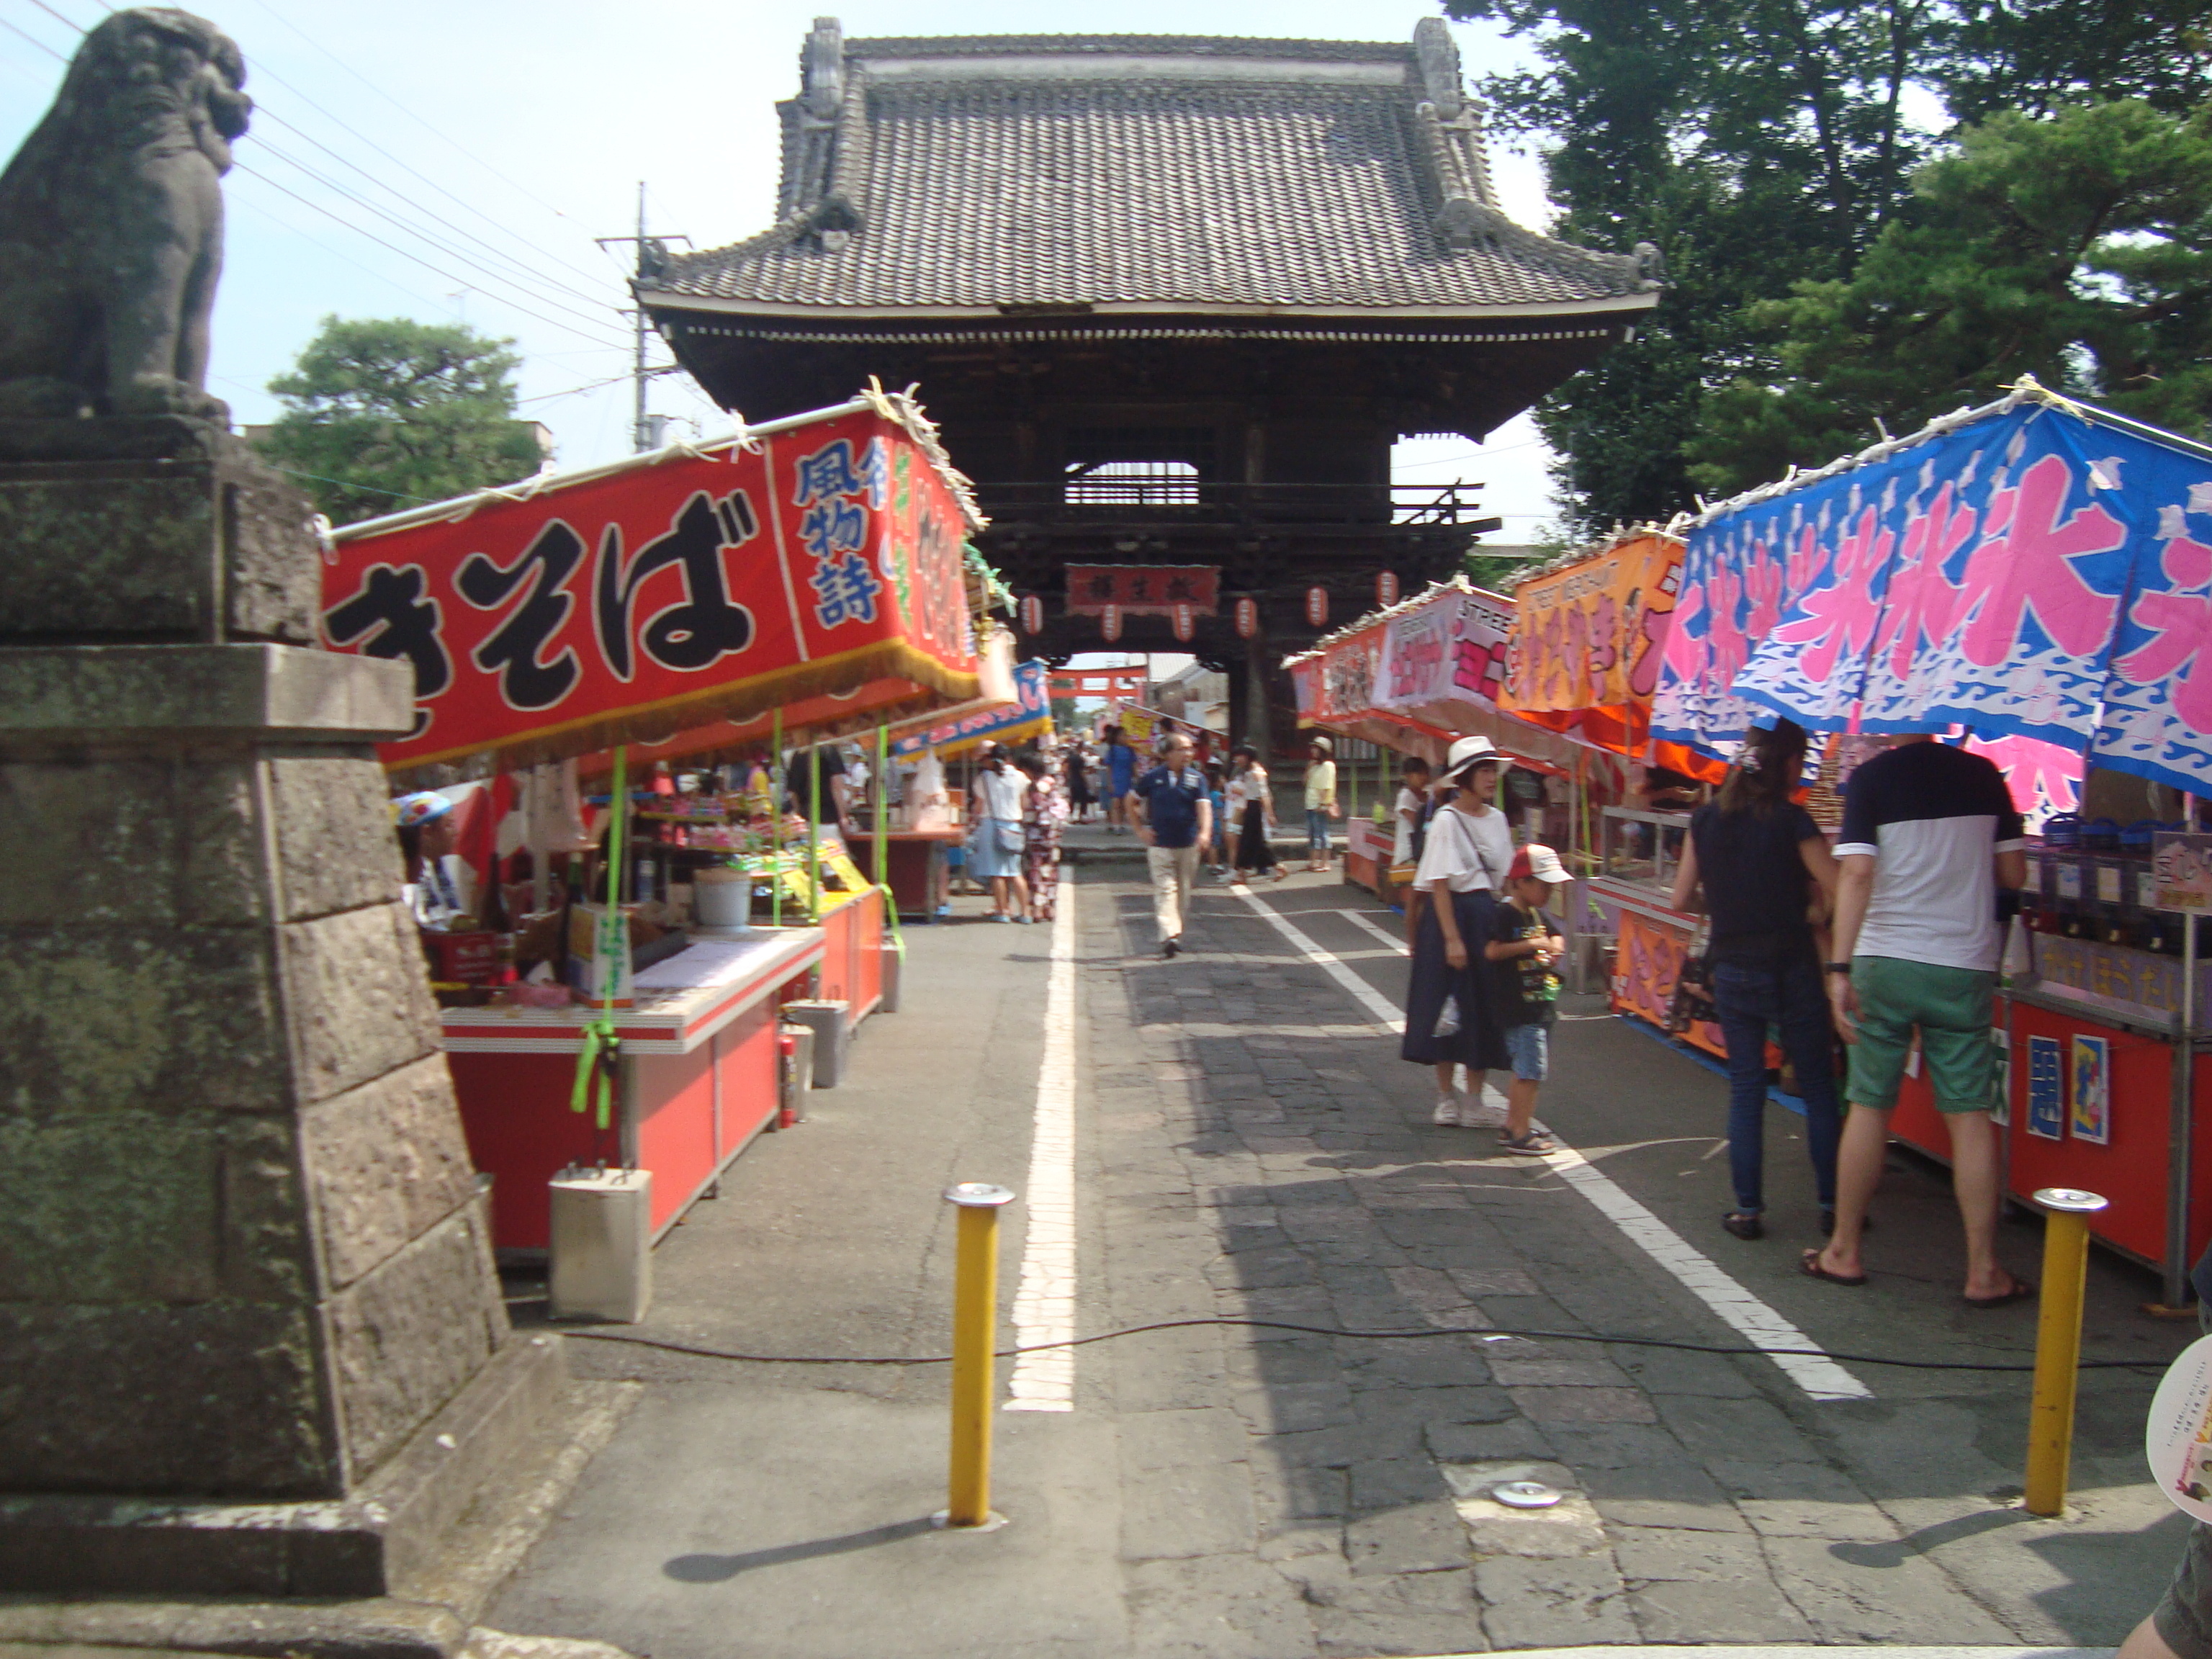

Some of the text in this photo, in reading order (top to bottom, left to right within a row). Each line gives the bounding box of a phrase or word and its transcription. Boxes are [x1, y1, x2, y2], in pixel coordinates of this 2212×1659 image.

[793, 438, 881, 629] 風物詩
[1943, 454, 2128, 668] 氷
